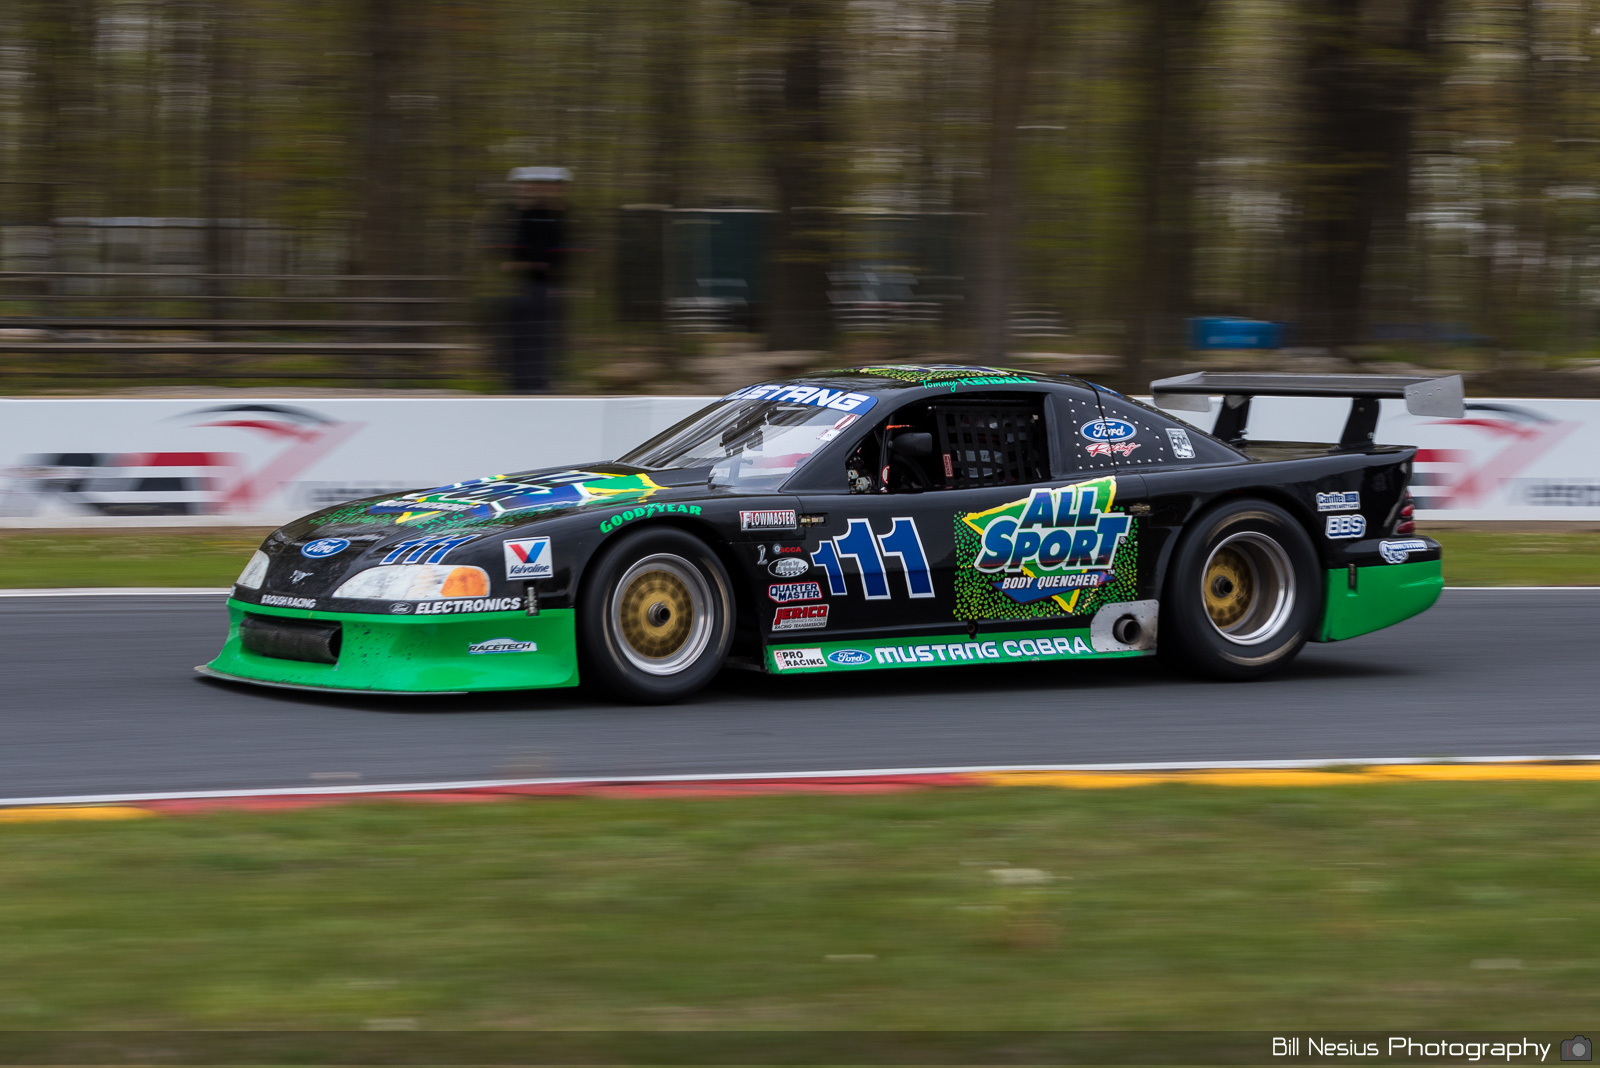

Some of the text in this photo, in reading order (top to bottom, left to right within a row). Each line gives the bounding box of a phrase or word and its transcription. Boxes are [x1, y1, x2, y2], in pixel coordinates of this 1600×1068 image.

[918, 376, 1037, 393] Tommy KENDALL
[1093, 422, 1125, 438] Ford
[1085, 442, 1141, 457] Racing
[1018, 487, 1102, 529] ALL
[600, 503, 702, 534] GOODYEAR
[741, 511, 796, 529] FLOWMASTER
[1327, 515, 1364, 537] BBS
[379, 534, 482, 565] 111
[780, 546, 802, 554] SCCA
[974, 513, 1133, 573] SPORT
[810, 516, 936, 600] 111
[510, 563, 550, 574] Valvoline
[770, 583, 818, 597] QUARTER
[1002, 574, 1099, 590] BODY QUENCHER
[287, 597, 317, 609] RACING
[778, 590, 820, 601] MASTER
[415, 597, 521, 615] ELECTRONICS
[774, 605, 828, 625] JERICO
[468, 642, 532, 652] RACETECH
[782, 651, 803, 659] PRO
[837, 636, 1093, 664] Ford MUSTANG COBRA
[785, 658, 825, 667] RACING
